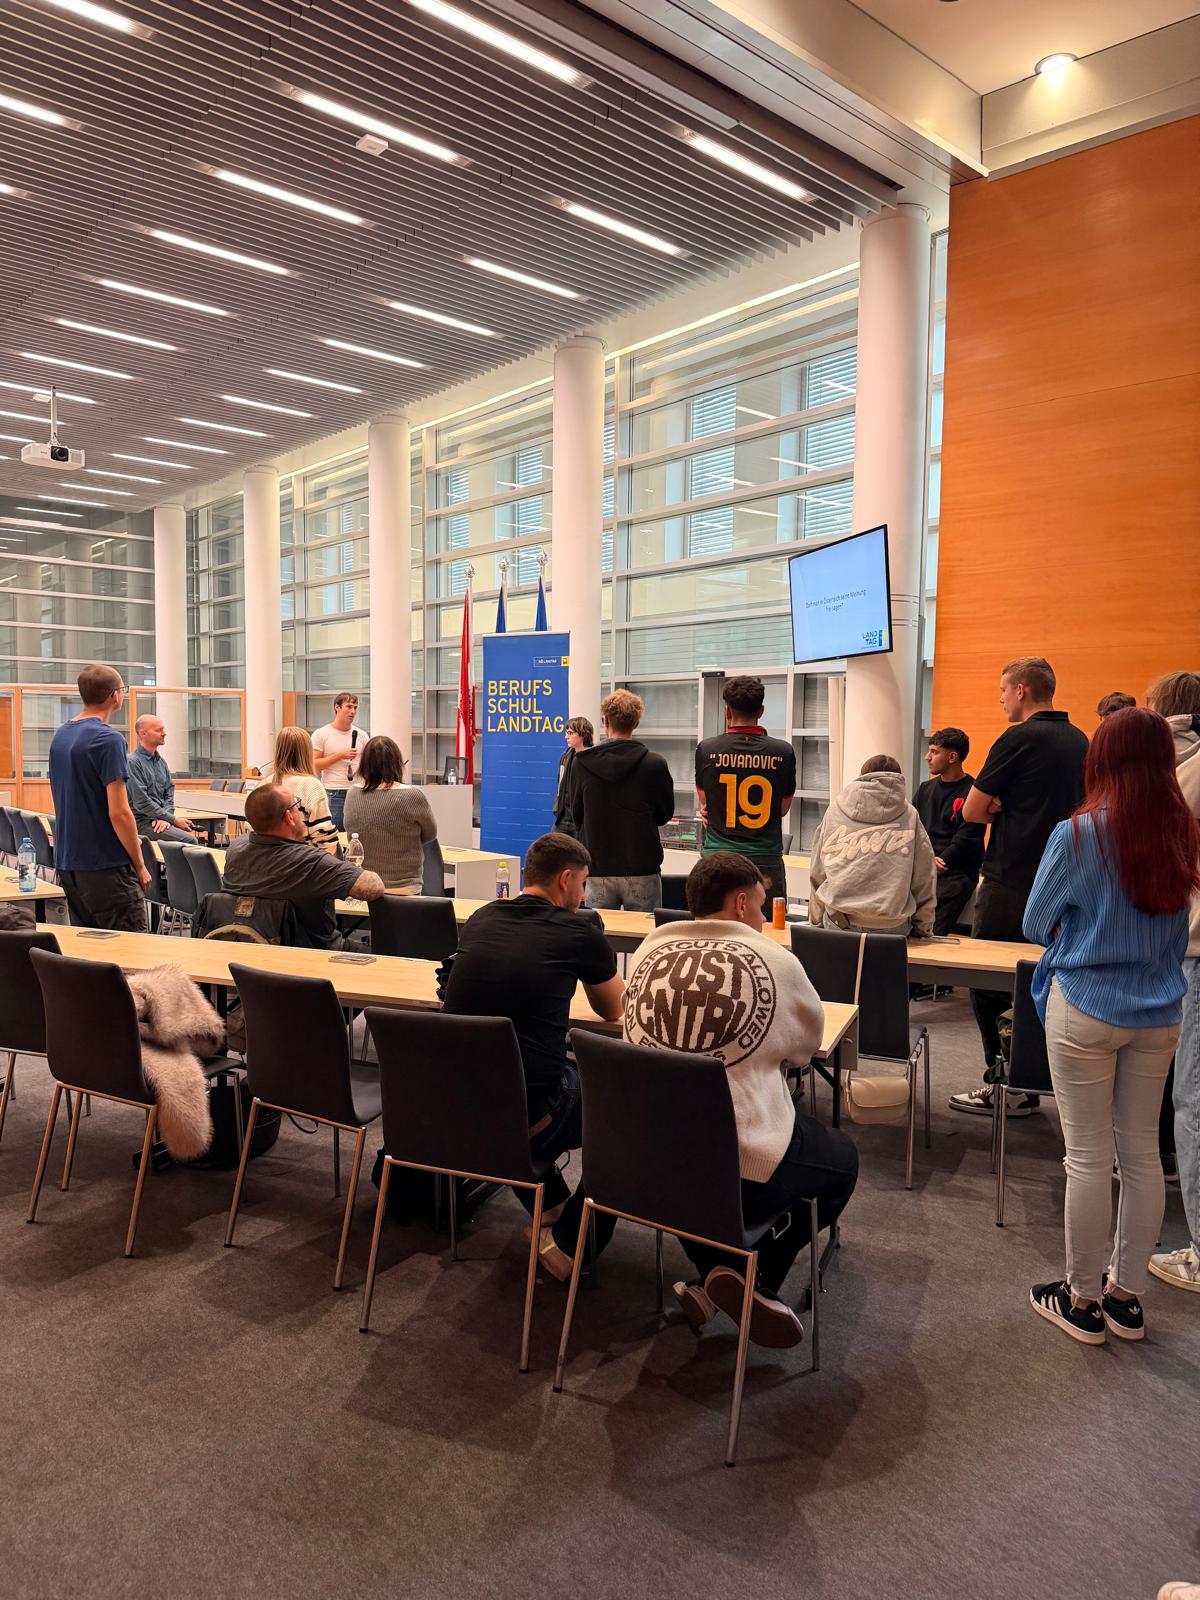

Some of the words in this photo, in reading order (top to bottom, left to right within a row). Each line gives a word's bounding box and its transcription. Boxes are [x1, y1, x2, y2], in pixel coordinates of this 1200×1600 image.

[862, 630, 878, 639] LAND
[865, 637, 878, 645] TAG
[487, 679, 553, 696] BERUFS
[487, 698, 543, 714] SCHUL
[487, 716, 564, 733] LANDTAG
[719, 773, 773, 829] 19
[643, 949, 748, 1000] POST
[630, 941, 742, 1000] SHORTCUTS
[738, 953, 772, 1049] ALLOWED
